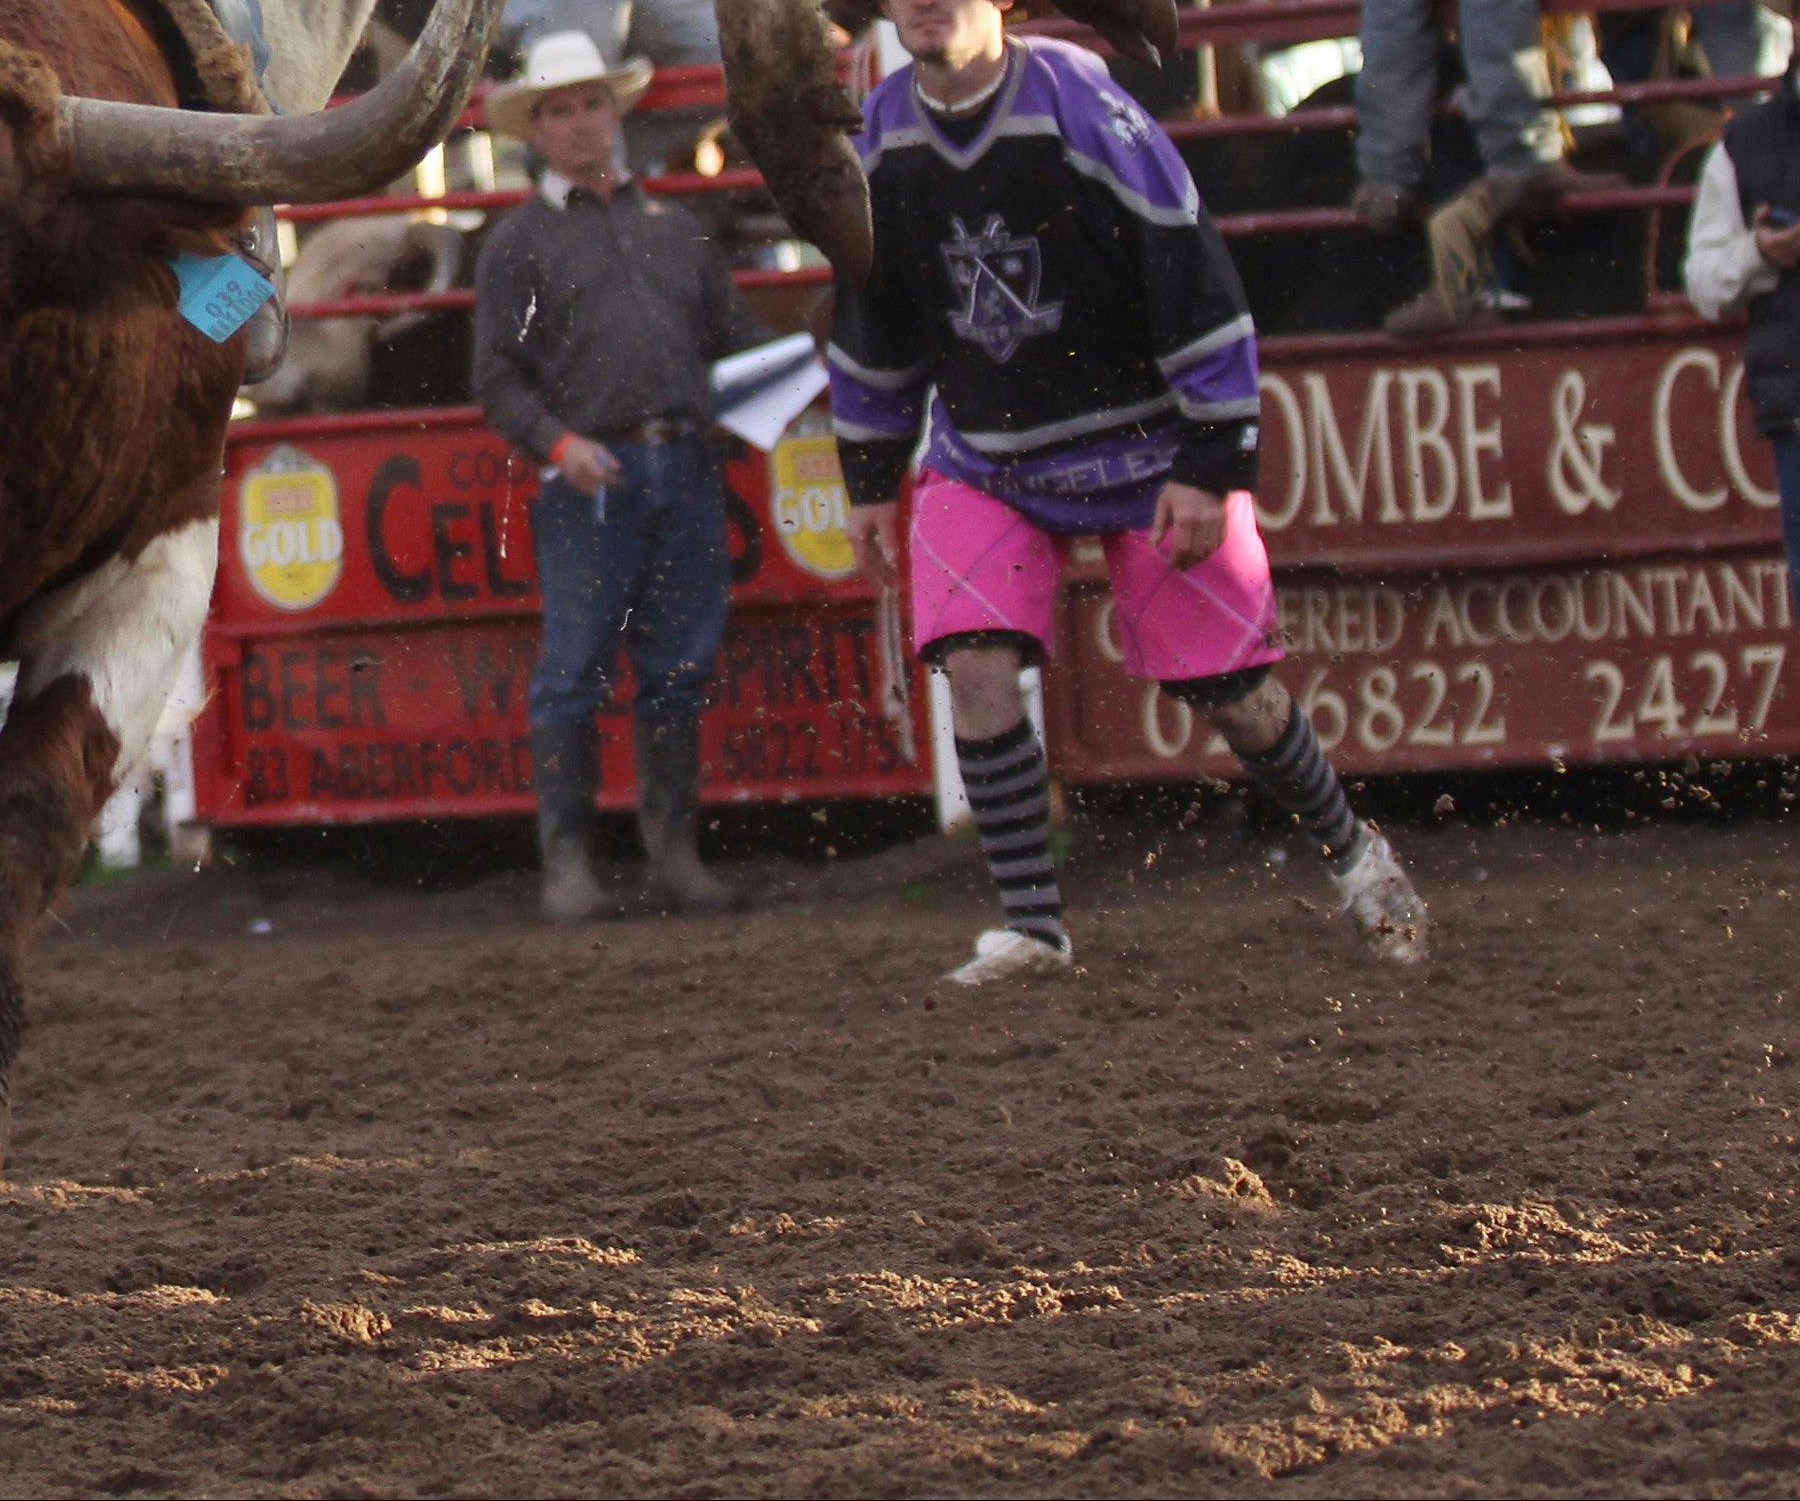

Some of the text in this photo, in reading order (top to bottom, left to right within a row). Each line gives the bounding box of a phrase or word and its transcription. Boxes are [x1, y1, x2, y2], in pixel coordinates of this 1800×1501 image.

[1258, 365, 1513, 532] OMBE
[1547, 369, 1621, 517] &
[241, 517, 344, 569] GOLD
[771, 484, 849, 536] GOL
[1097, 585, 1404, 663] CERED
[242, 647, 387, 733] BEER
[1301, 663, 1507, 752] 6822
[1583, 644, 1787, 742] 2427
